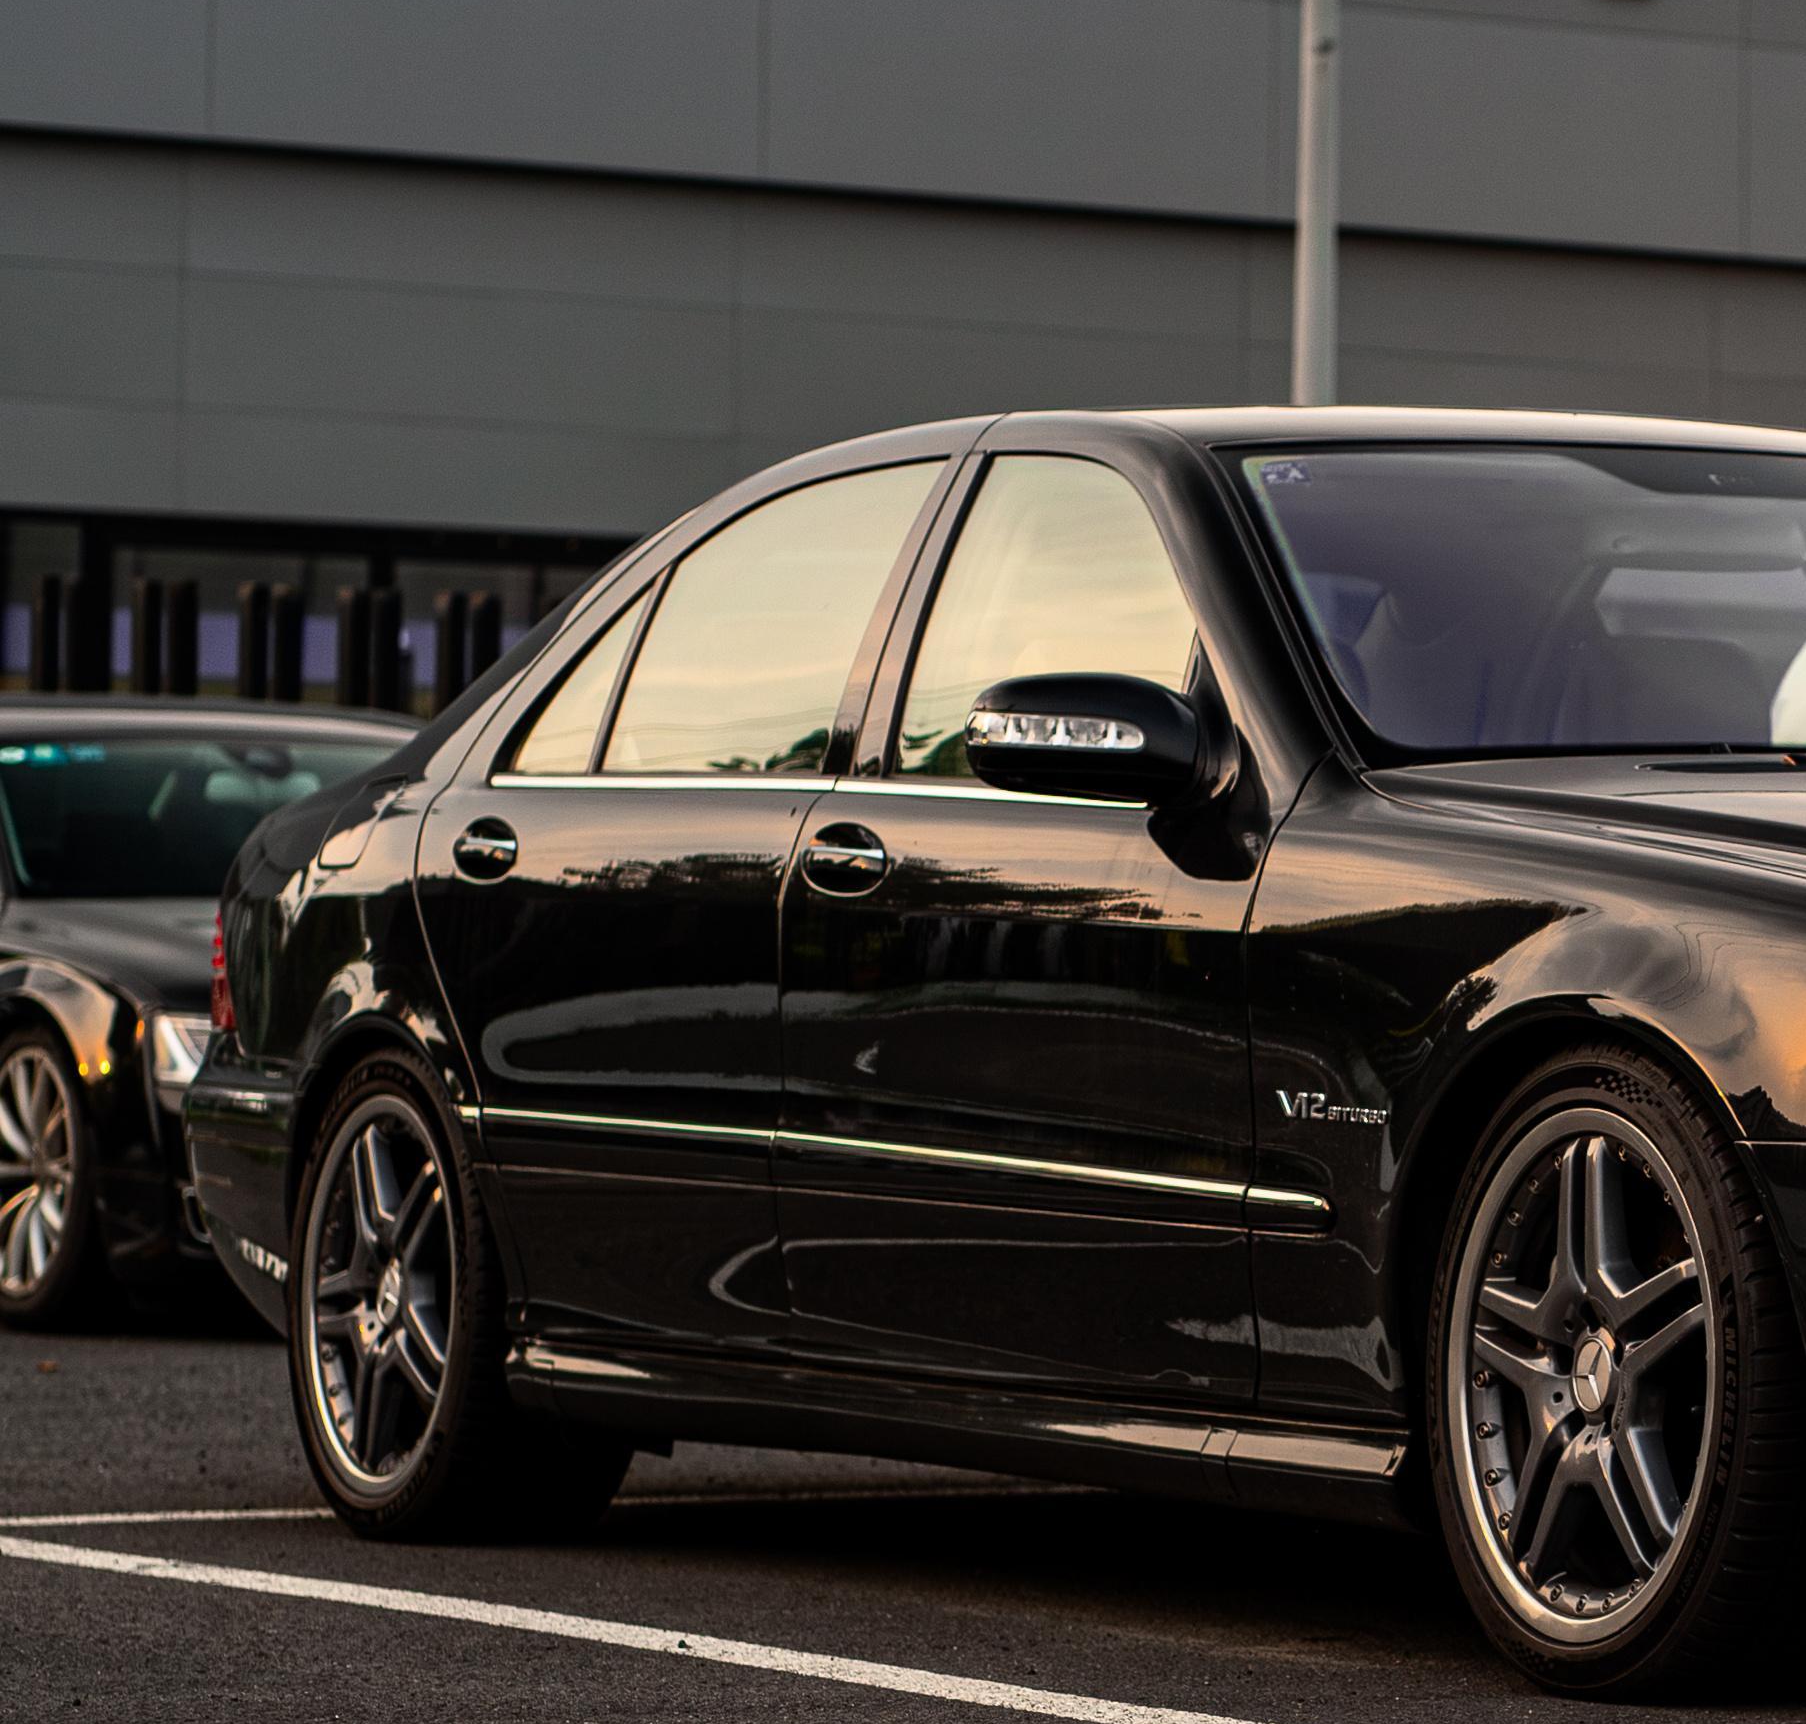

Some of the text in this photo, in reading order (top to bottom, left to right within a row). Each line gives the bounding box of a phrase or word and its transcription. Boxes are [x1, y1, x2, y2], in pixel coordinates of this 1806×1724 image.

[1275, 1089, 1388, 1125] V12 BITURBO
[1715, 1326, 1737, 1487] MICHELIN
